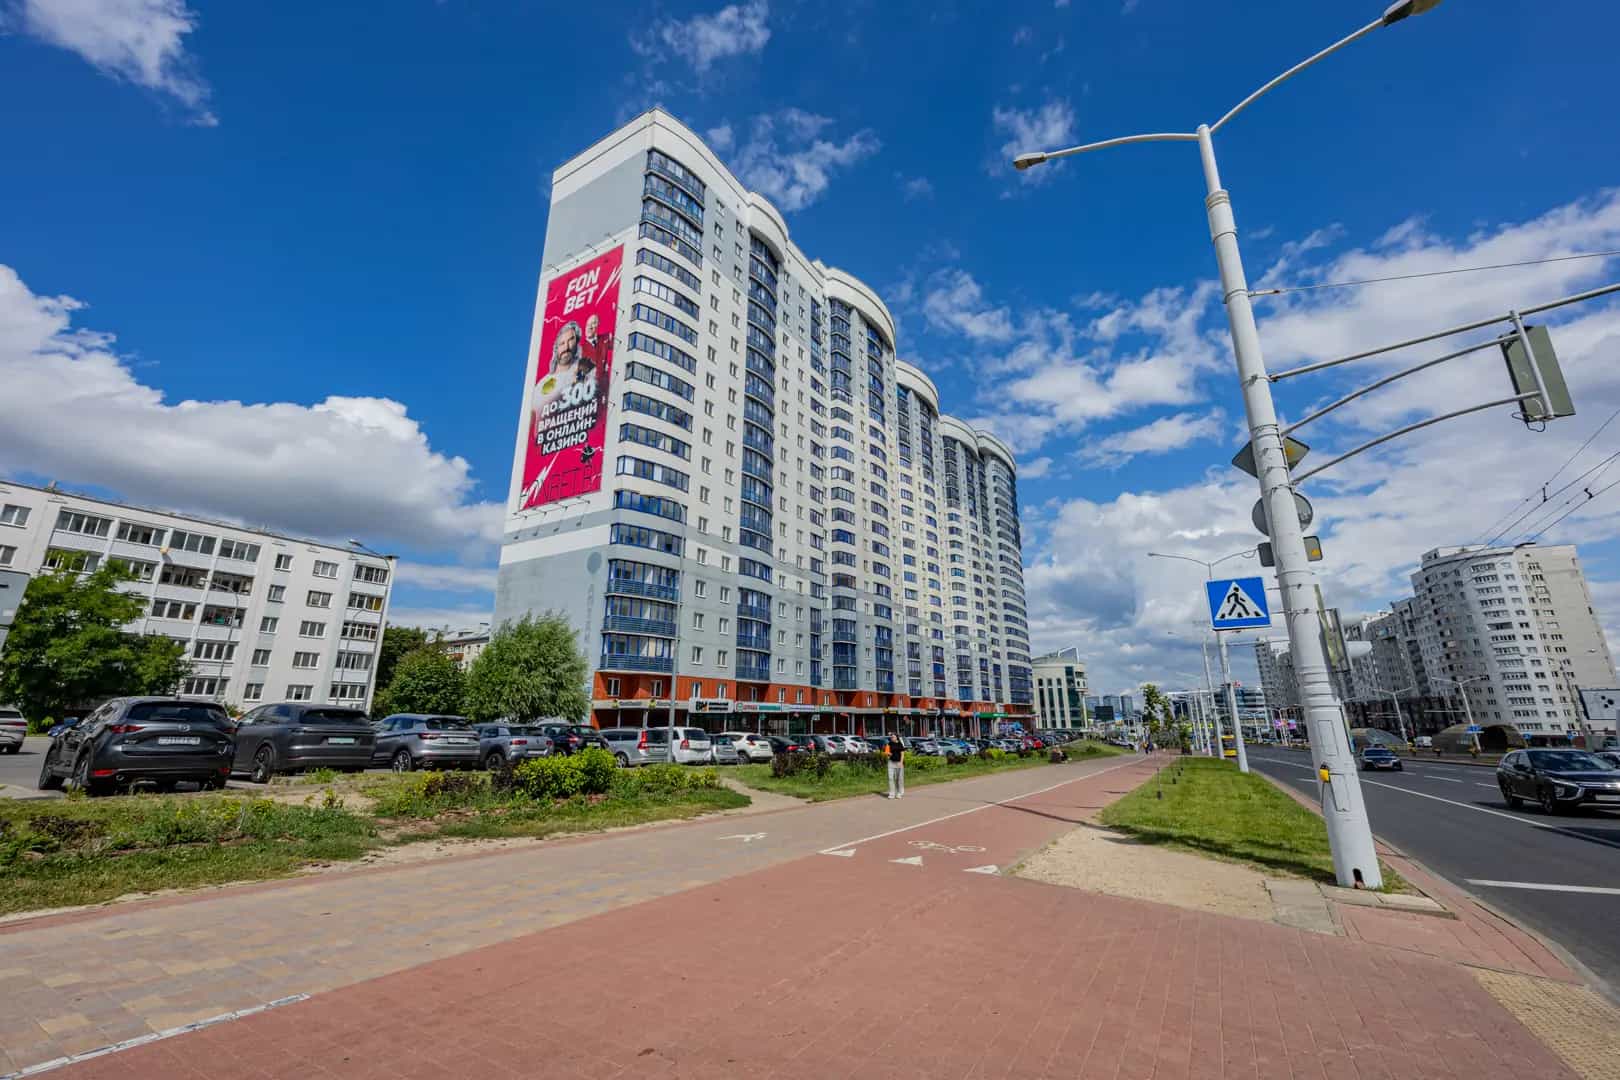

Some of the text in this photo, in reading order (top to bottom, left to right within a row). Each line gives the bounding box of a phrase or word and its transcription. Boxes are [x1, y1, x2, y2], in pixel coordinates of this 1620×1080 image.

[565, 266, 600, 298] FON
[563, 284, 599, 316] BET
[541, 379, 597, 418] ДО 300
[538, 399, 598, 433] ВРАЩЕНИЙ
[537, 432, 545, 445] В
[542, 431, 588, 456] КАЗИНО
